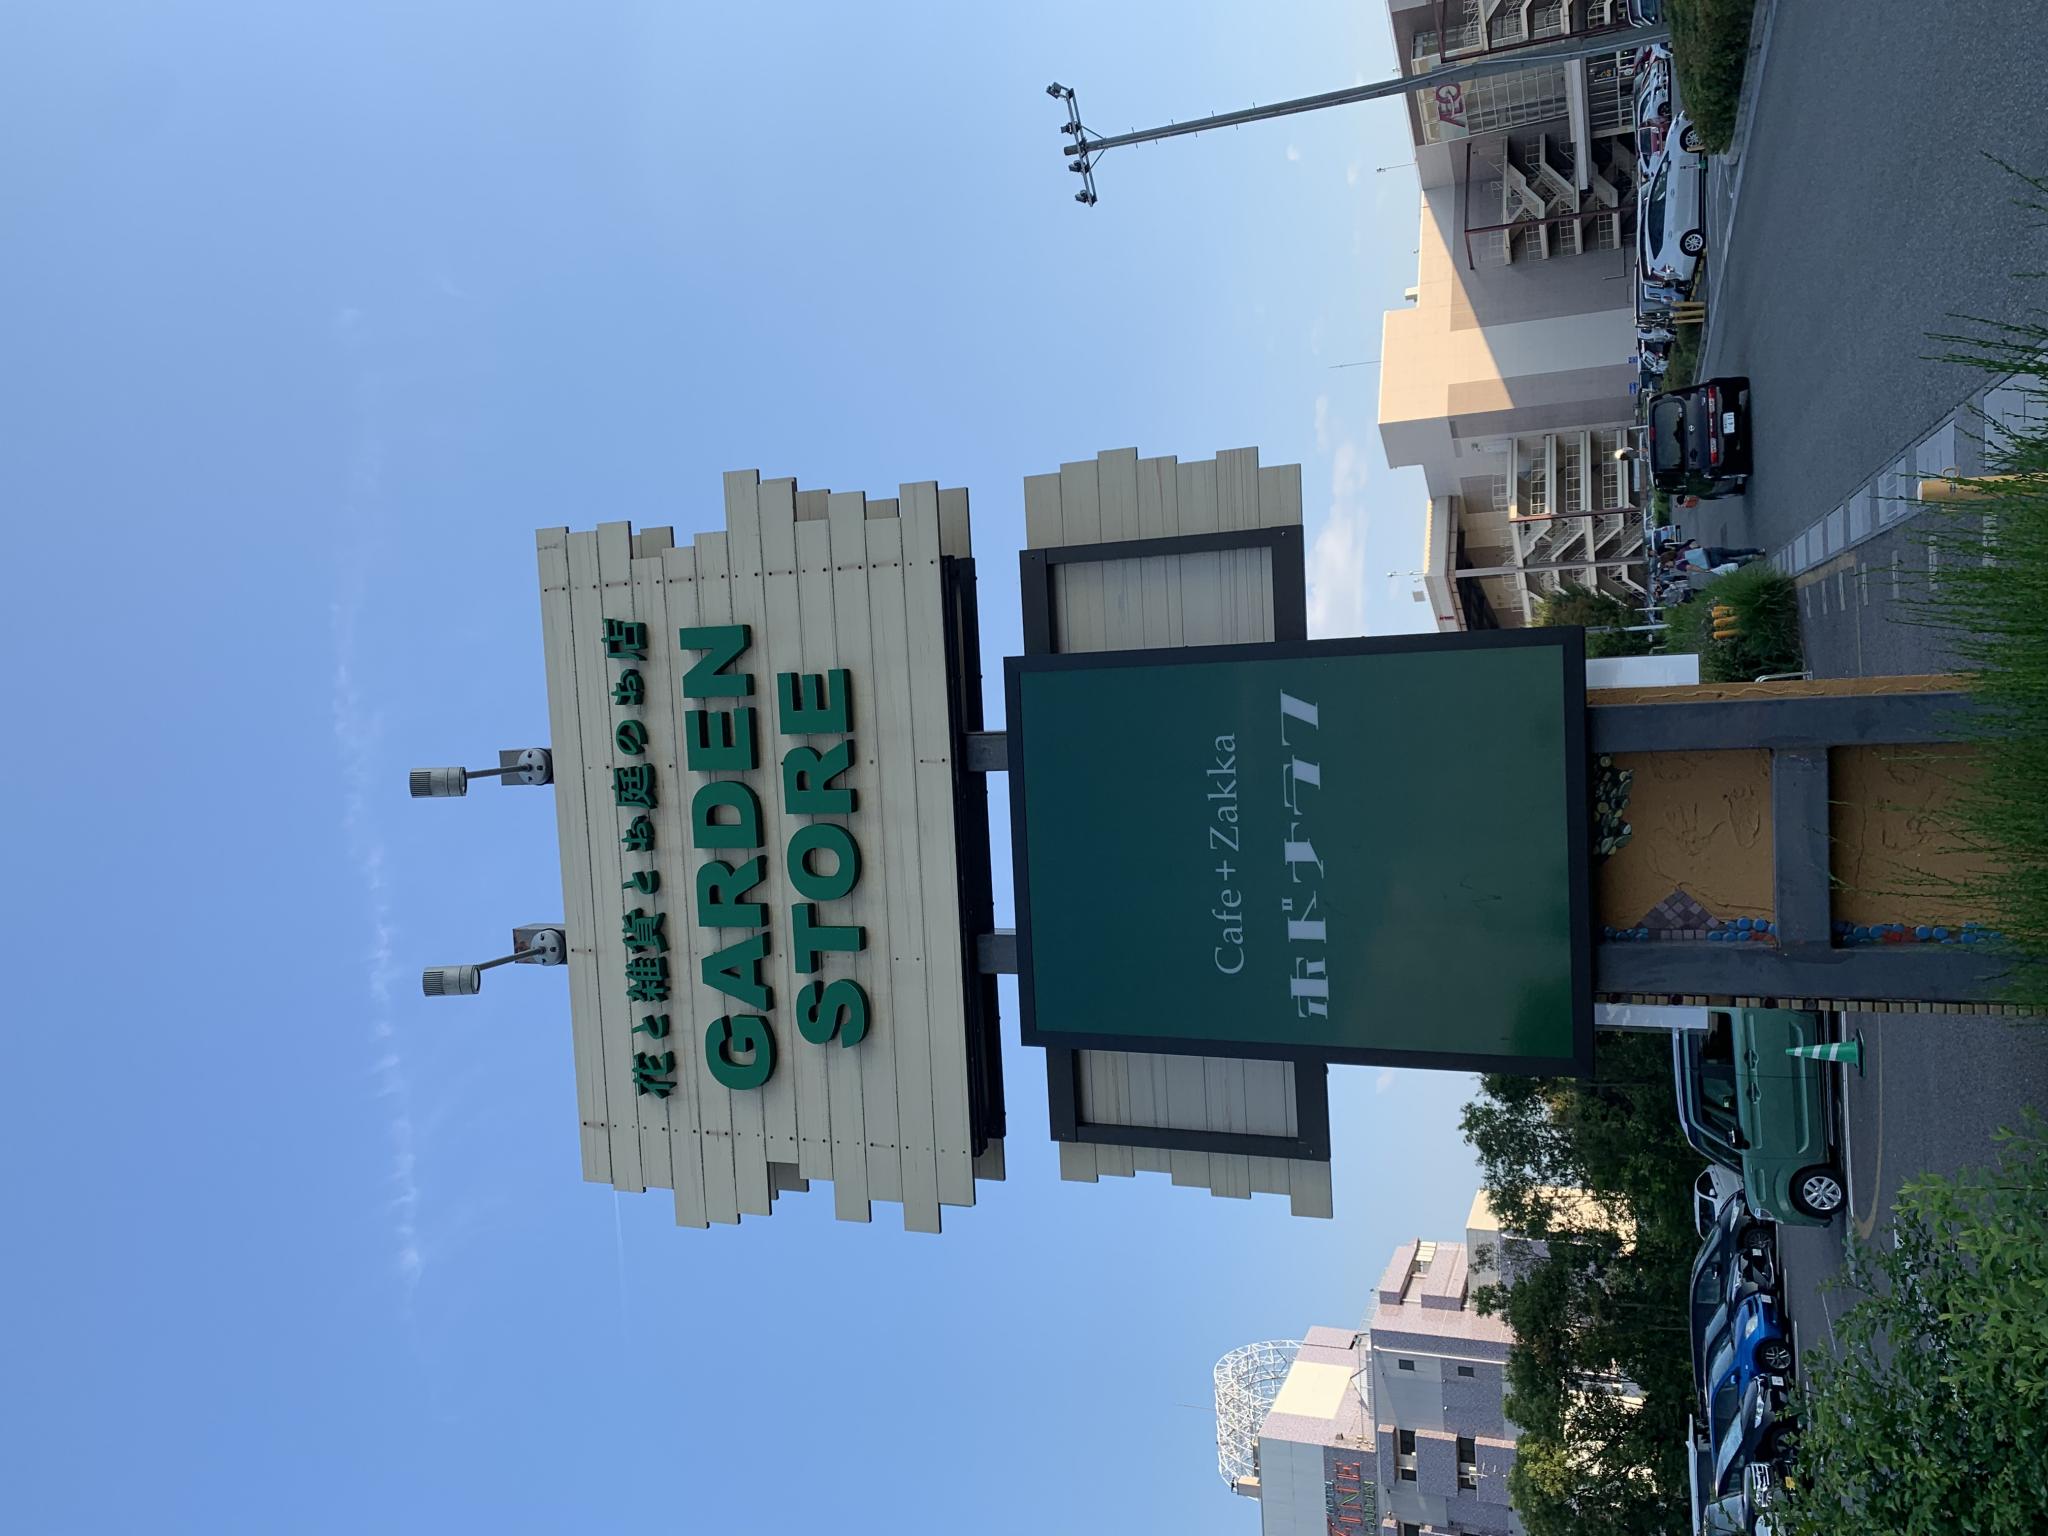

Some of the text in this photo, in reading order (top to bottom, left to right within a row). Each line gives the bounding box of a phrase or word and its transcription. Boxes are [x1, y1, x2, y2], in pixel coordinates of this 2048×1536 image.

[601, 618, 676, 1099] 花と雑貨とお庭のお店
[679, 623, 777, 1091] GARDEN
[776, 668, 869, 1049] STORE
